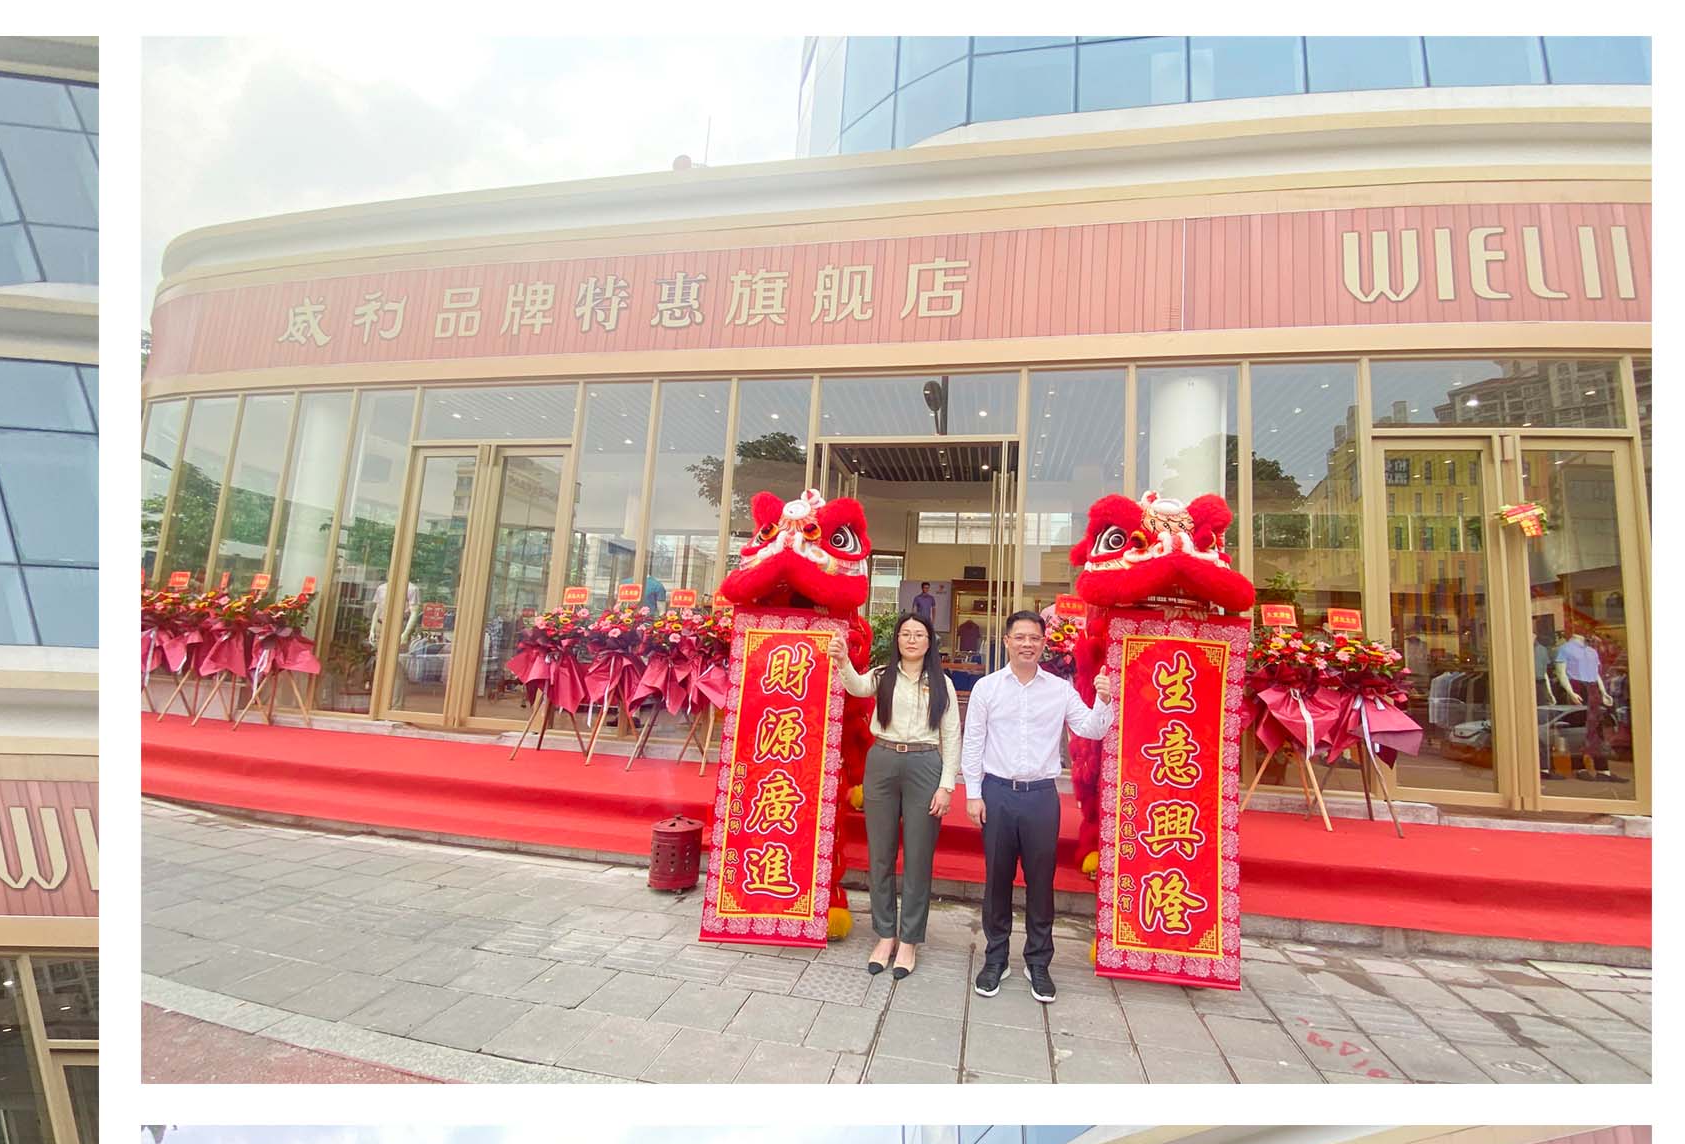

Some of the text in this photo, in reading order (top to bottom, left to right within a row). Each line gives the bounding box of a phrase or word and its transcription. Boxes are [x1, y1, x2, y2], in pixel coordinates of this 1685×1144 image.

[277, 258, 971, 346] 威利品牌特惠旗舰店
[1342, 225, 1636, 302] WIELII
[744, 643, 814, 896] 財源廣進
[1140, 652, 1207, 932] 生意興隆
